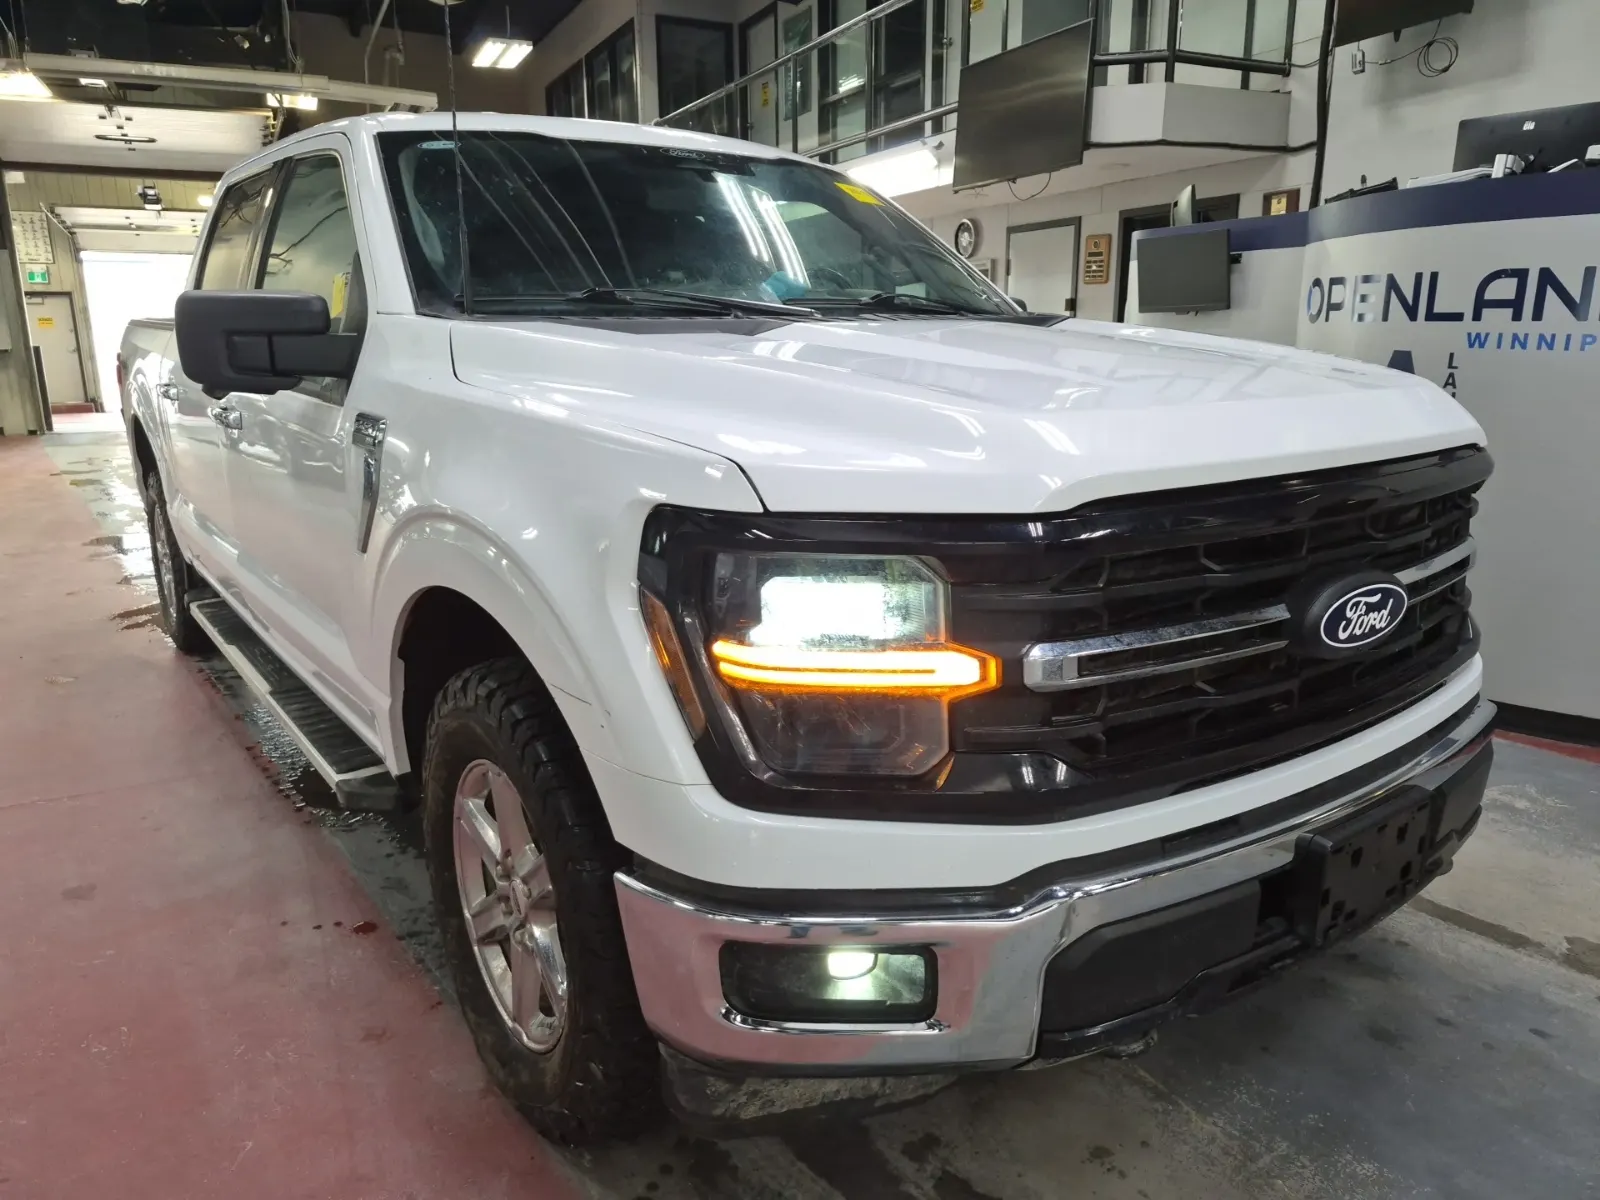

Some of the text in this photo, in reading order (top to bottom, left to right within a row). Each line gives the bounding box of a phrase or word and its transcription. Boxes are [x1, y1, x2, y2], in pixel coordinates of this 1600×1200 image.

[1306, 266, 1600, 324] OPENLAN
[1467, 332, 1598, 352] WINNIP
[1443, 352, 1458, 399] LA
[1338, 593, 1394, 640] Ford
